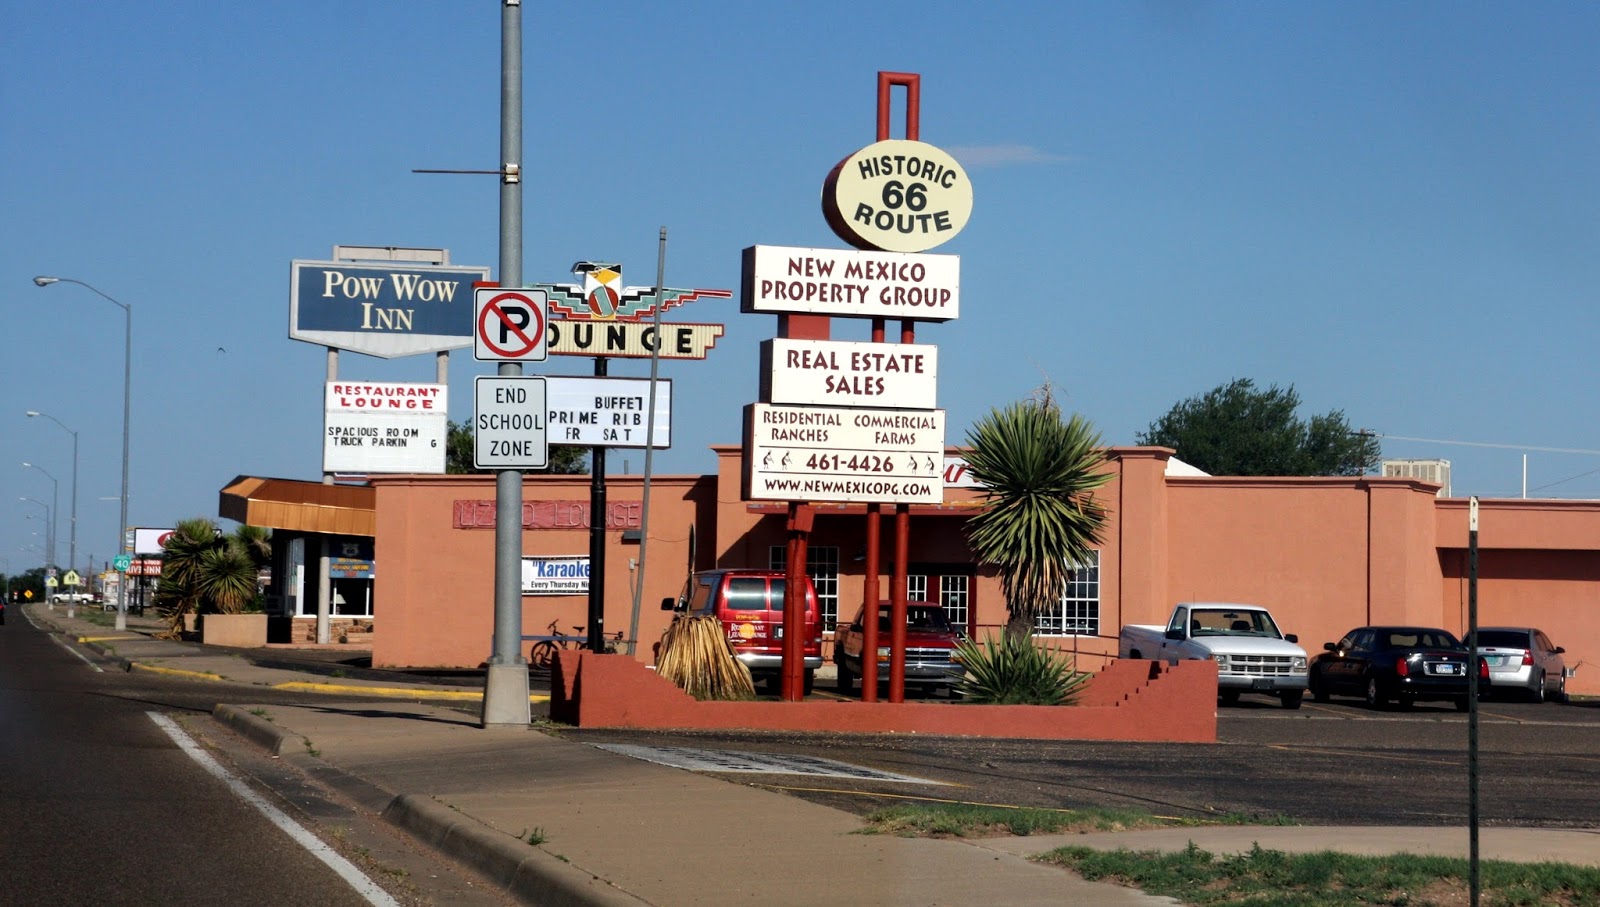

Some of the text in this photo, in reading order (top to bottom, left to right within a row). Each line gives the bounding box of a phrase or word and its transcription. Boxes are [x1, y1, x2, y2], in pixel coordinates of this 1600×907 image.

[858, 155, 957, 189] HISTORIC
[882, 180, 928, 212] 66
[854, 202, 952, 234] ROUTE
[788, 257, 926, 282] NEW MEXICO
[761, 280, 951, 308] PROPERTY GROUP
[548, 323, 692, 353] OUNGE
[787, 349, 924, 374] REAL ESTATE
[334, 385, 440, 397] RESTAURANT
[825, 375, 885, 395] SALES
[341, 397, 433, 409] LOUNGE
[496, 388, 526, 404] END
[479, 414, 543, 430] SCHOOL
[549, 411, 641, 425] PRIME RIB
[763, 411, 936, 430] RESIDENTIAL COMMERCIAL
[328, 427, 378, 437] SPACIOUS
[566, 428, 632, 441] FR SAT
[771, 428, 916, 445] RANCHES FARMS
[333, 437, 363, 446] TRUCK
[490, 440, 532, 456] ZONE
[806, 453, 894, 473] 461-4426
[765, 479, 931, 496] WWW.NEWMEXICOPG.COM
[461, 503, 534, 526] LIZD
[116, 560, 128, 568] 40
[531, 581, 548, 589] Every
[550, 581, 579, 589] Thursday
